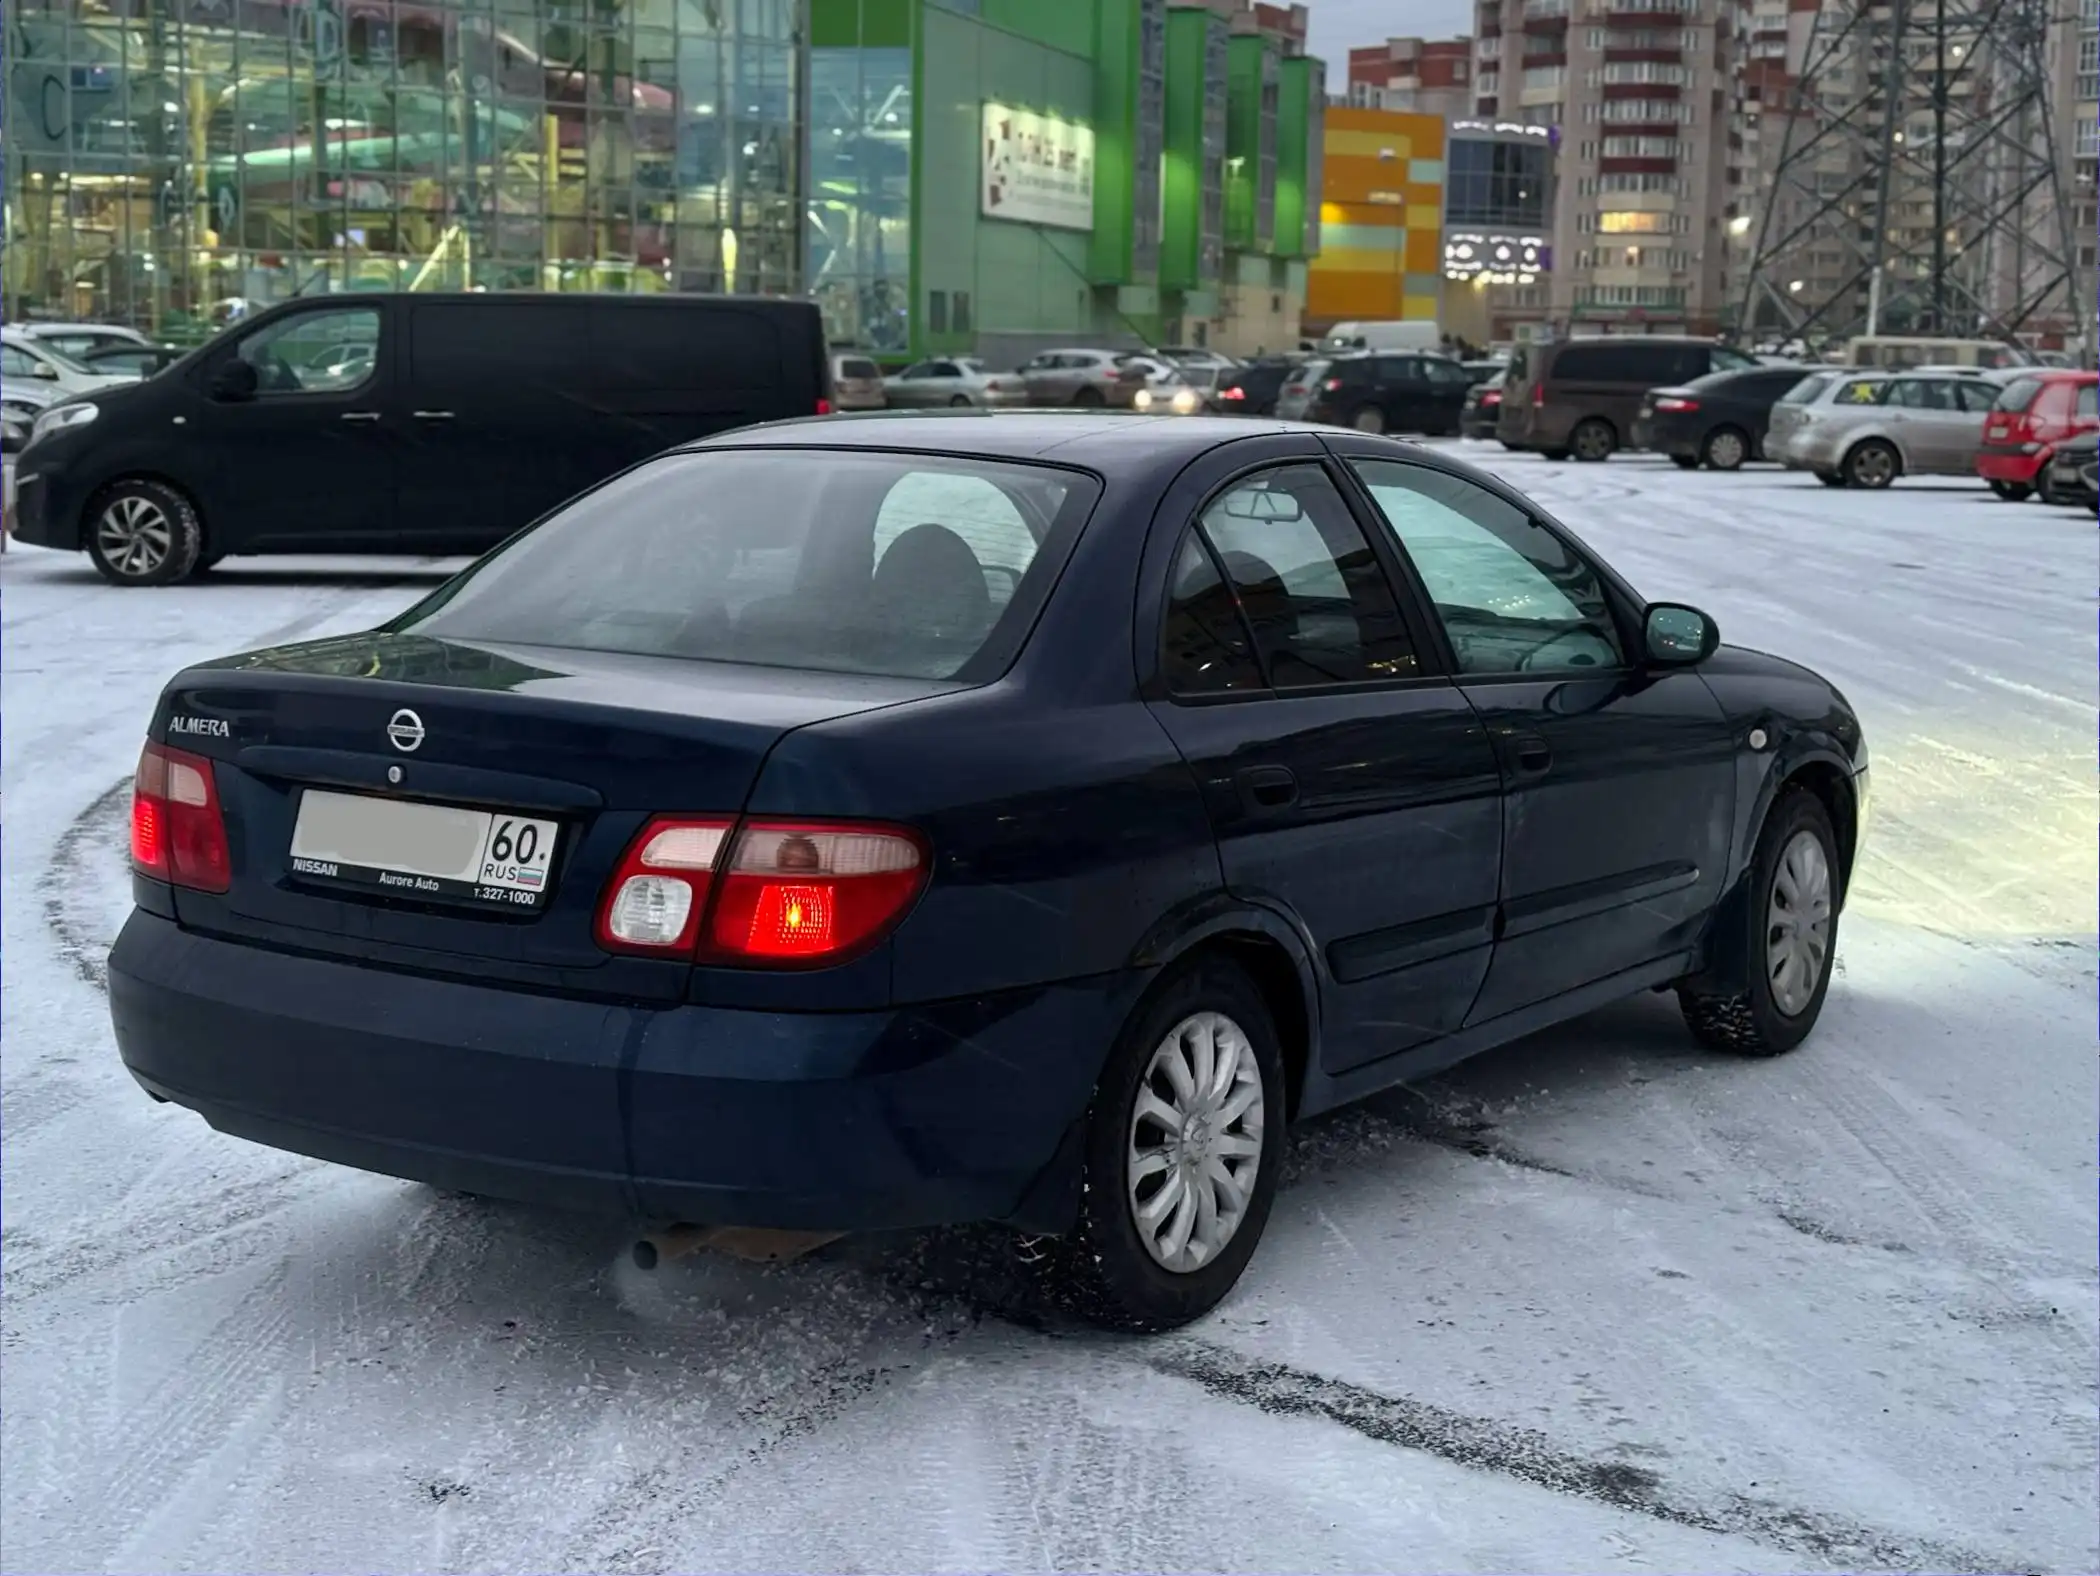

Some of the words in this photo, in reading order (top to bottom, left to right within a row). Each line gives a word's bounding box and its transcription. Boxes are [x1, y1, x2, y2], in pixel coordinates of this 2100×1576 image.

[168, 716, 229, 737] ALMERA
[292, 858, 338, 876] NISSAN
[483, 863, 517, 880] RUS
[379, 872, 413, 887] Aurore
[415, 877, 439, 891] Auto
